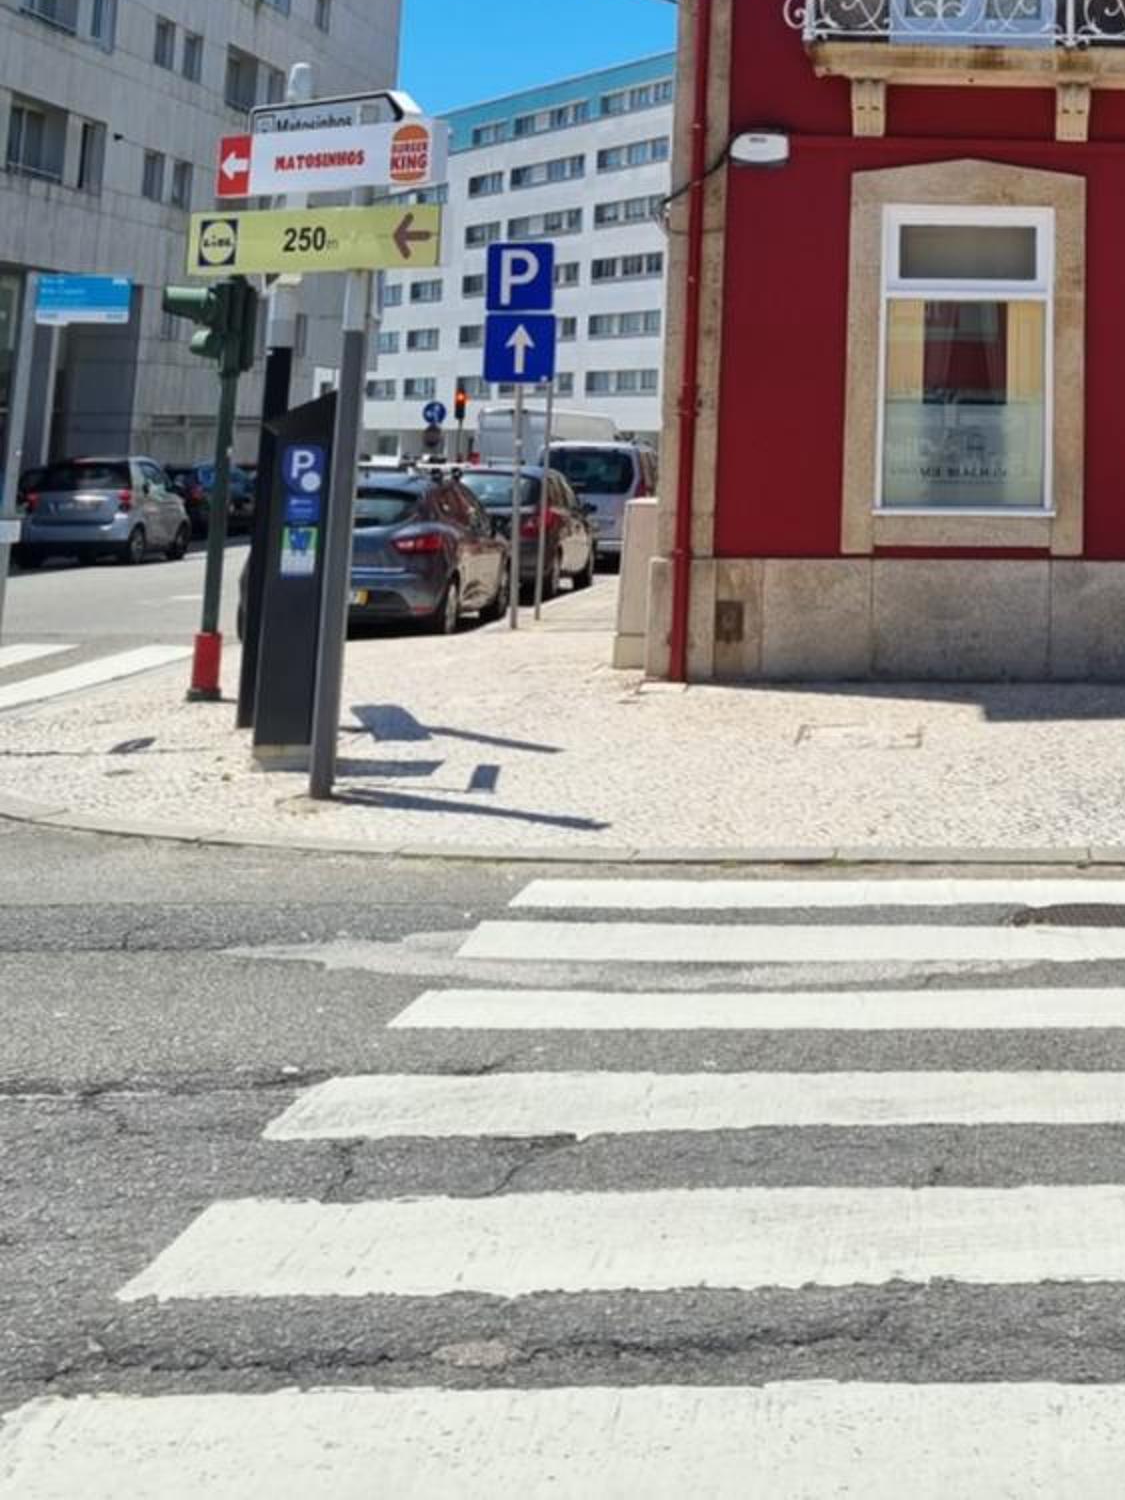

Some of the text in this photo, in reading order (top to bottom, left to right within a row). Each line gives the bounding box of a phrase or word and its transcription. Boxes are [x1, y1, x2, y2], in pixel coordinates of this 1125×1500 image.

[392, 141, 428, 153] BURGER
[275, 150, 365, 172] MATOSINHOS
[391, 153, 427, 170] KING
[501, 249, 540, 306] P
[291, 449, 315, 479] P
